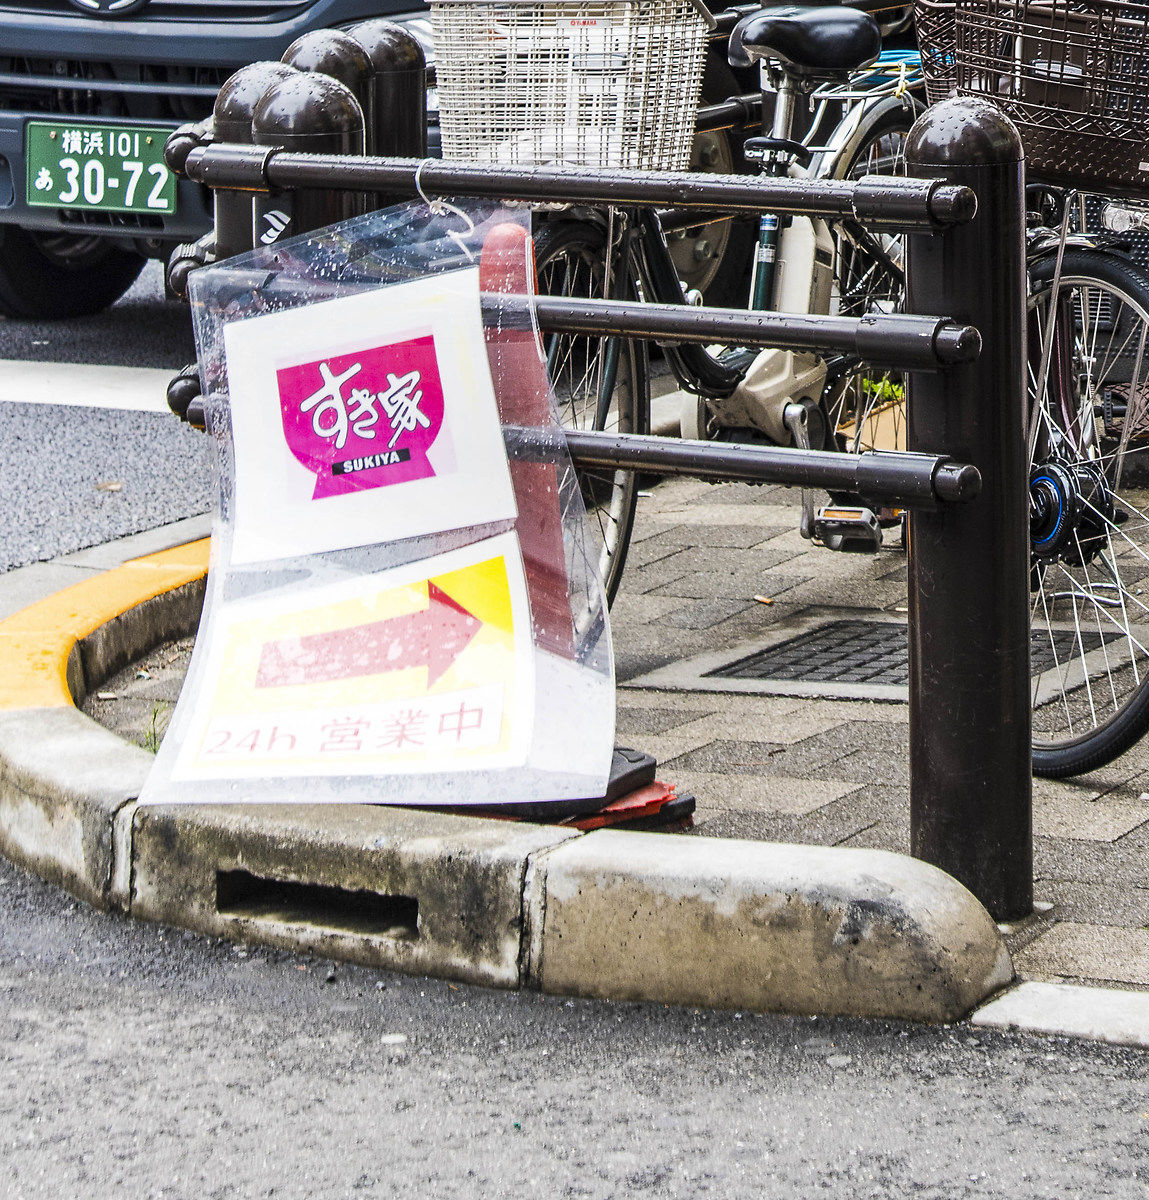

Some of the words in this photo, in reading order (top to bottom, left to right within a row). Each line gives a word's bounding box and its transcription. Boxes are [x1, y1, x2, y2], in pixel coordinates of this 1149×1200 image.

[62, 129, 104, 155] 横浜
[109, 131, 140, 158] 101
[34, 166, 54, 191] あ
[58, 157, 169, 209] 30-72
[300, 362, 432, 449] すき家
[343, 450, 401, 474] SUKIYA
[205, 726, 297, 755] 24h
[318, 702, 484, 753] 営業中
